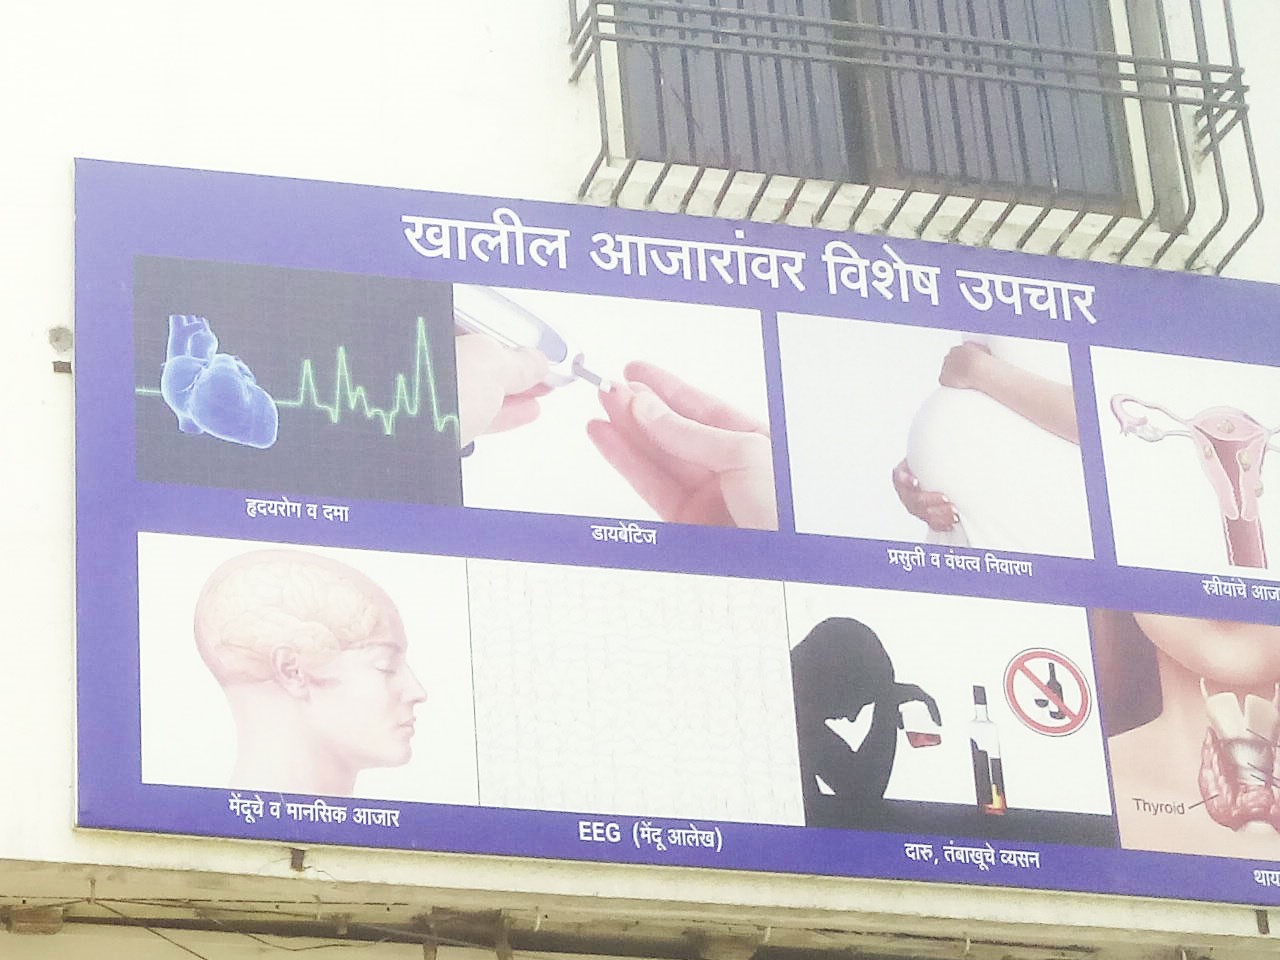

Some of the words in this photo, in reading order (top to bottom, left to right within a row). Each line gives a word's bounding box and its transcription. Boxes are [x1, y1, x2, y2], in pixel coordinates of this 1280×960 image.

[400, 207, 571, 270] खालील
[590, 229, 806, 292] आजारांवर
[822, 241, 941, 306] विशेष
[955, 269, 1097, 325] उपचार
[306, 503, 318, 519] व
[323, 505, 349, 522] दमा
[591, 521, 658, 545] डायबेटिज
[930, 552, 940, 568] व
[985, 553, 1033, 576] निवारण
[269, 801, 280, 819] व
[286, 799, 348, 824] मानसिक
[353, 807, 401, 828] आजार
[1132, 798, 1185, 815] Thyroid
[579, 820, 621, 843] EEG
[943, 840, 996, 870] तंबाखूचे
[1000, 849, 1040, 869] व्यसन
